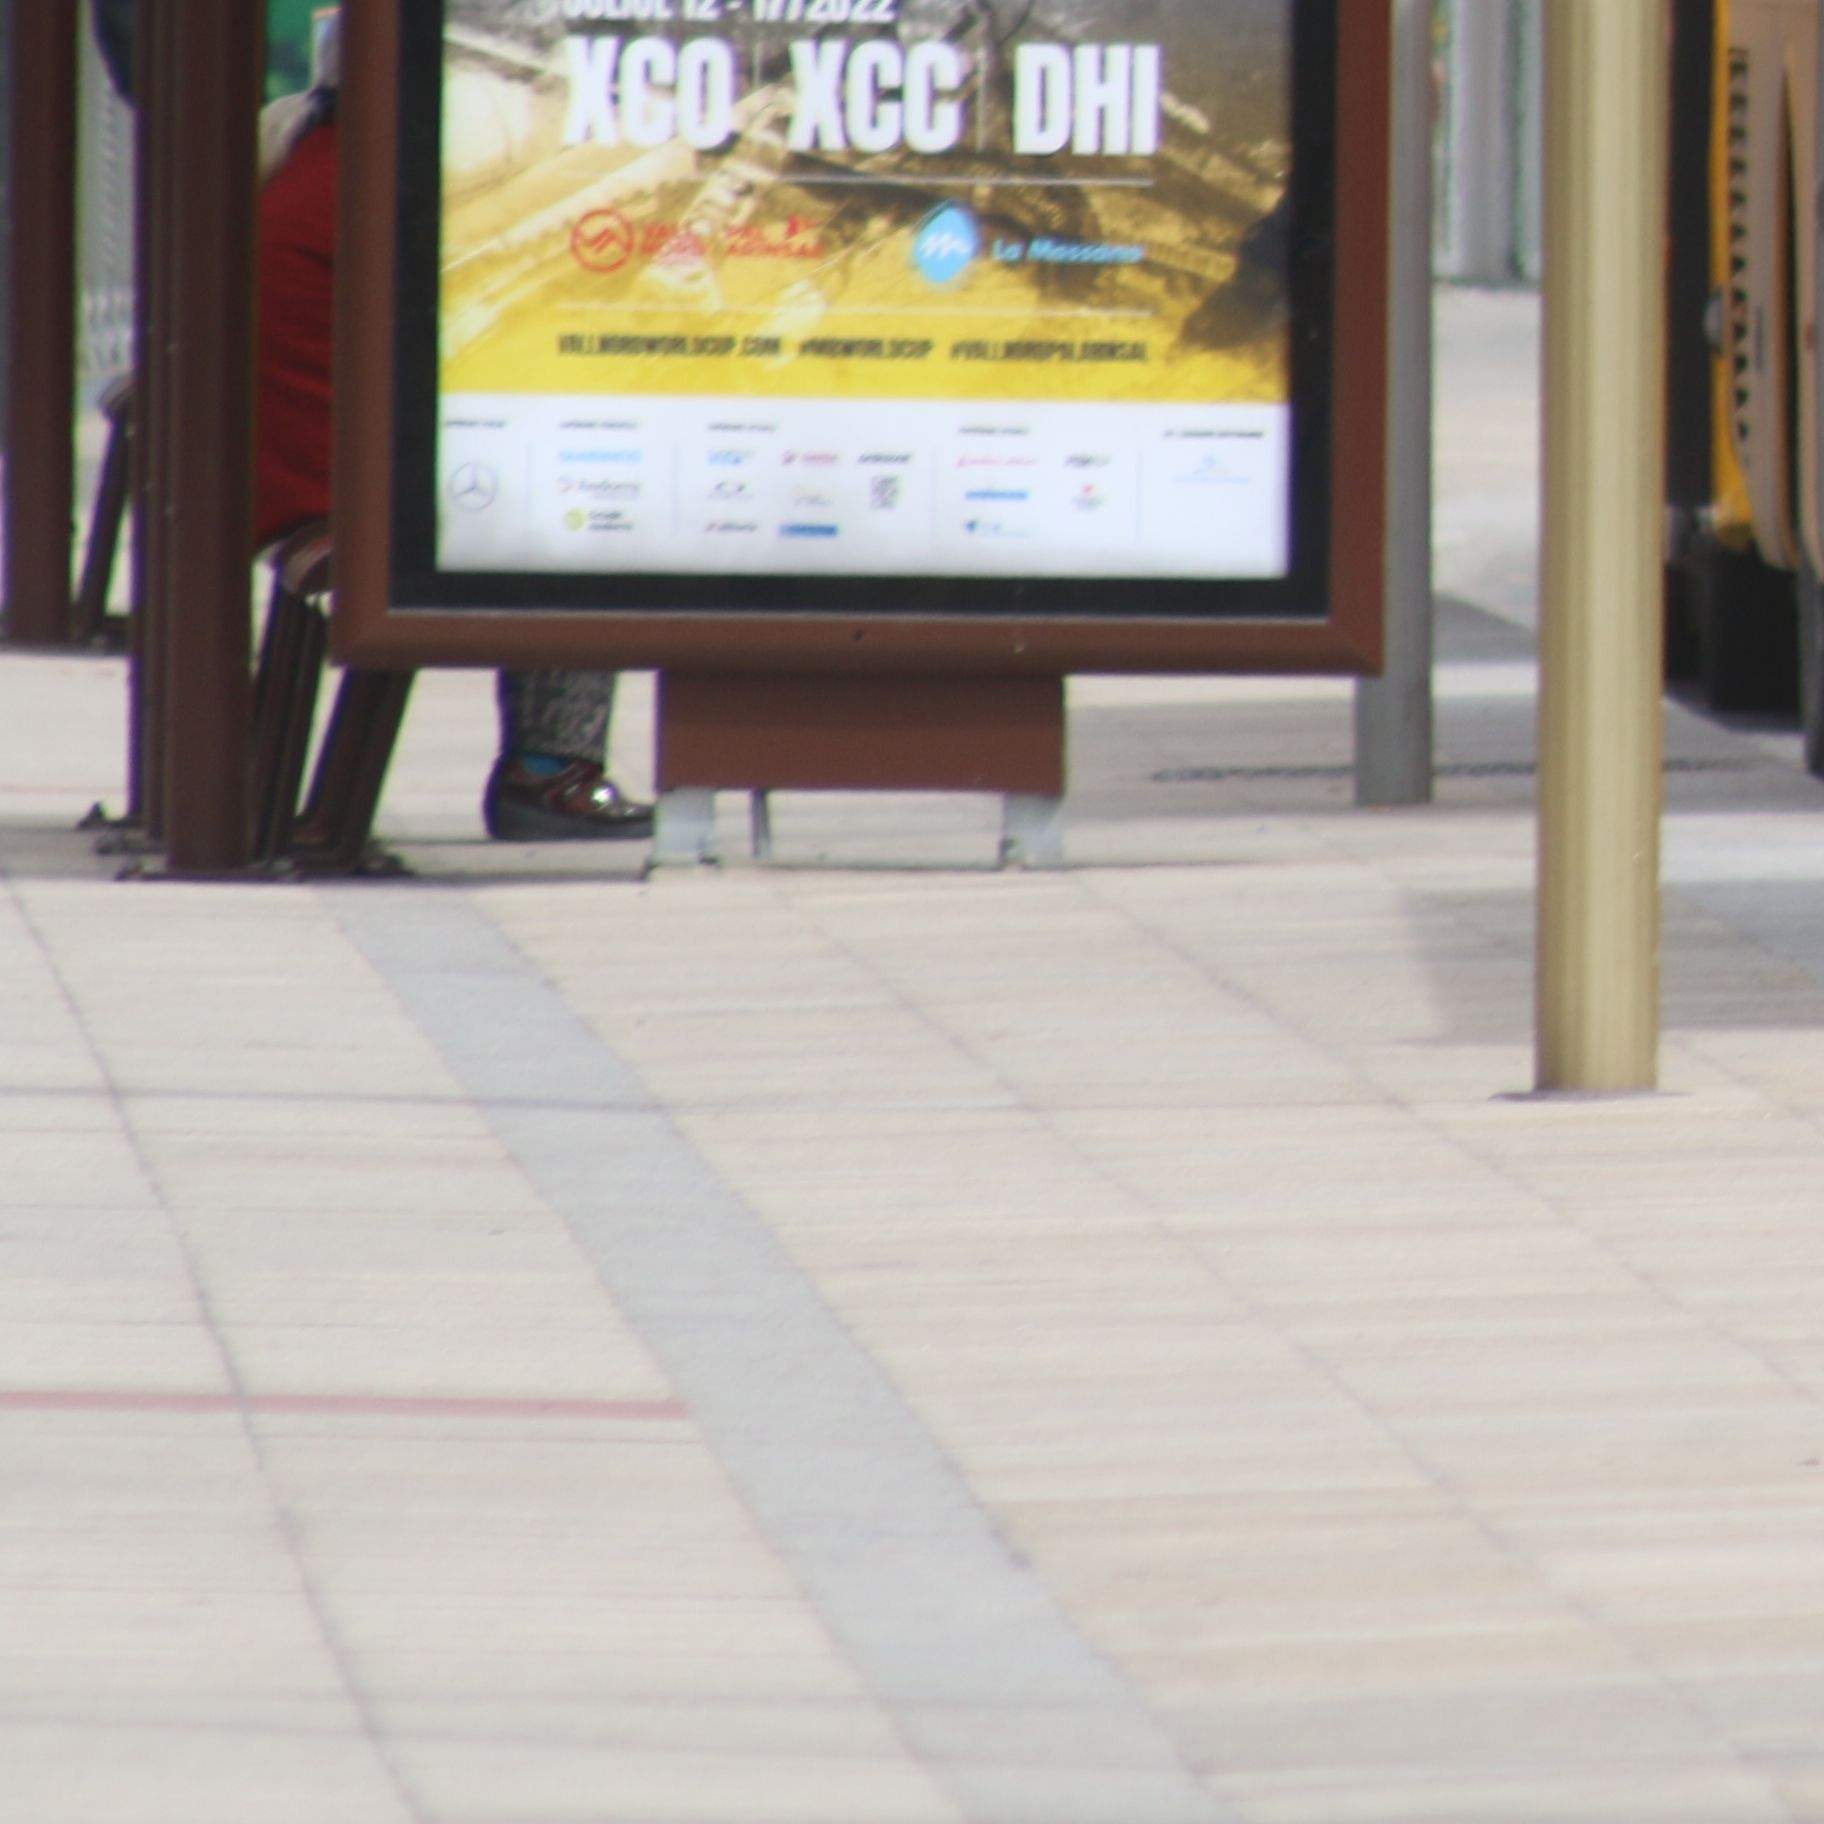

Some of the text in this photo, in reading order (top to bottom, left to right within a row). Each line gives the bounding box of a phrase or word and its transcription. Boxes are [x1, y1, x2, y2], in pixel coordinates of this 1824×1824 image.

[564, 35, 1162, 156] XCO XCC DHI
